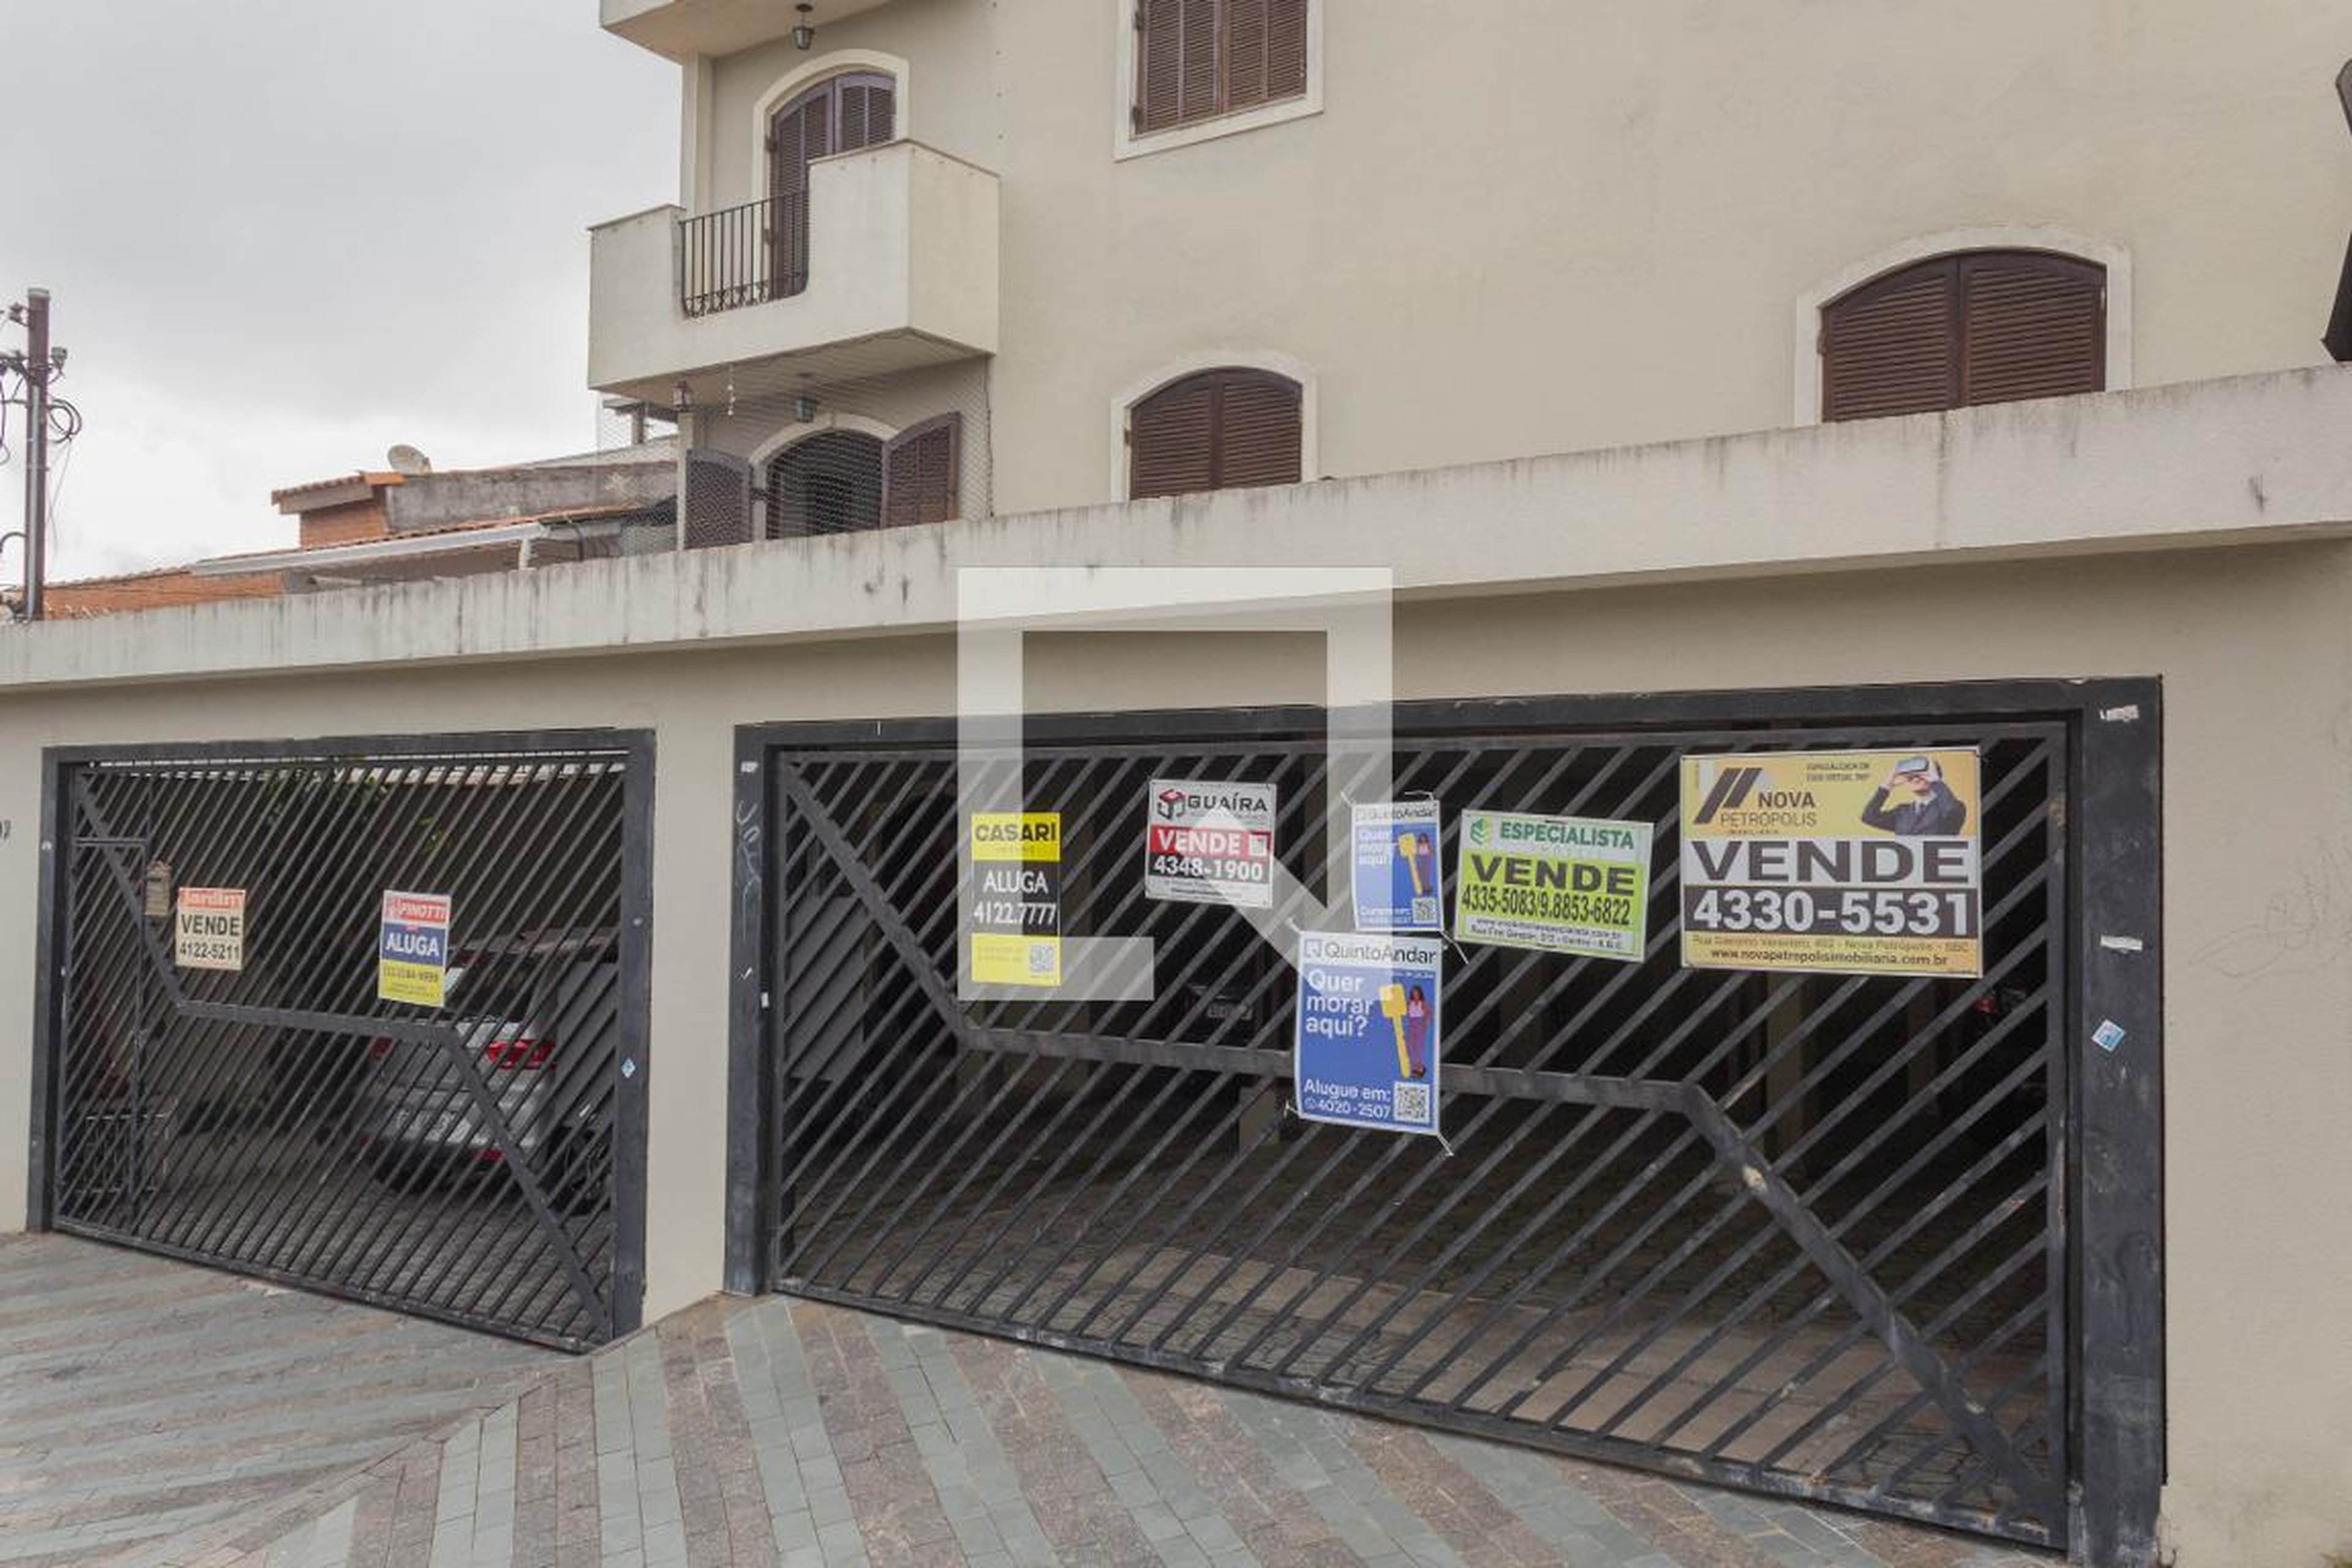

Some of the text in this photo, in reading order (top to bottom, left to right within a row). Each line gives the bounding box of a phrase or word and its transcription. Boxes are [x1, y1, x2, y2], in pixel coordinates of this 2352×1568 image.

[1188, 792, 1268, 812] GUAÍRA
[1758, 792, 1816, 809] NOVA
[974, 823, 1056, 842] CASARI
[1157, 829, 1242, 854] VENDE
[1501, 821, 1634, 850] ESPECIALISTA
[1154, 855, 1263, 881] 4348-1900
[1692, 840, 1969, 883] VENDE
[982, 870, 1049, 894] ALUGA
[1471, 854, 1635, 895] VENDE
[973, 900, 1057, 924] 4122.7777
[1693, 889, 1969, 937] 4330-5531
[181, 914, 240, 936] VENDE
[179, 941, 239, 960] 4122-5211
[385, 932, 440, 957] ALUGA
[1324, 941, 1436, 963] QuintoAndar
[1307, 968, 1365, 992] Quer
[1306, 995, 1374, 1015] morar
[1305, 1015, 1368, 1039] aqui?
[1304, 1078, 1391, 1102] Alugue em:
